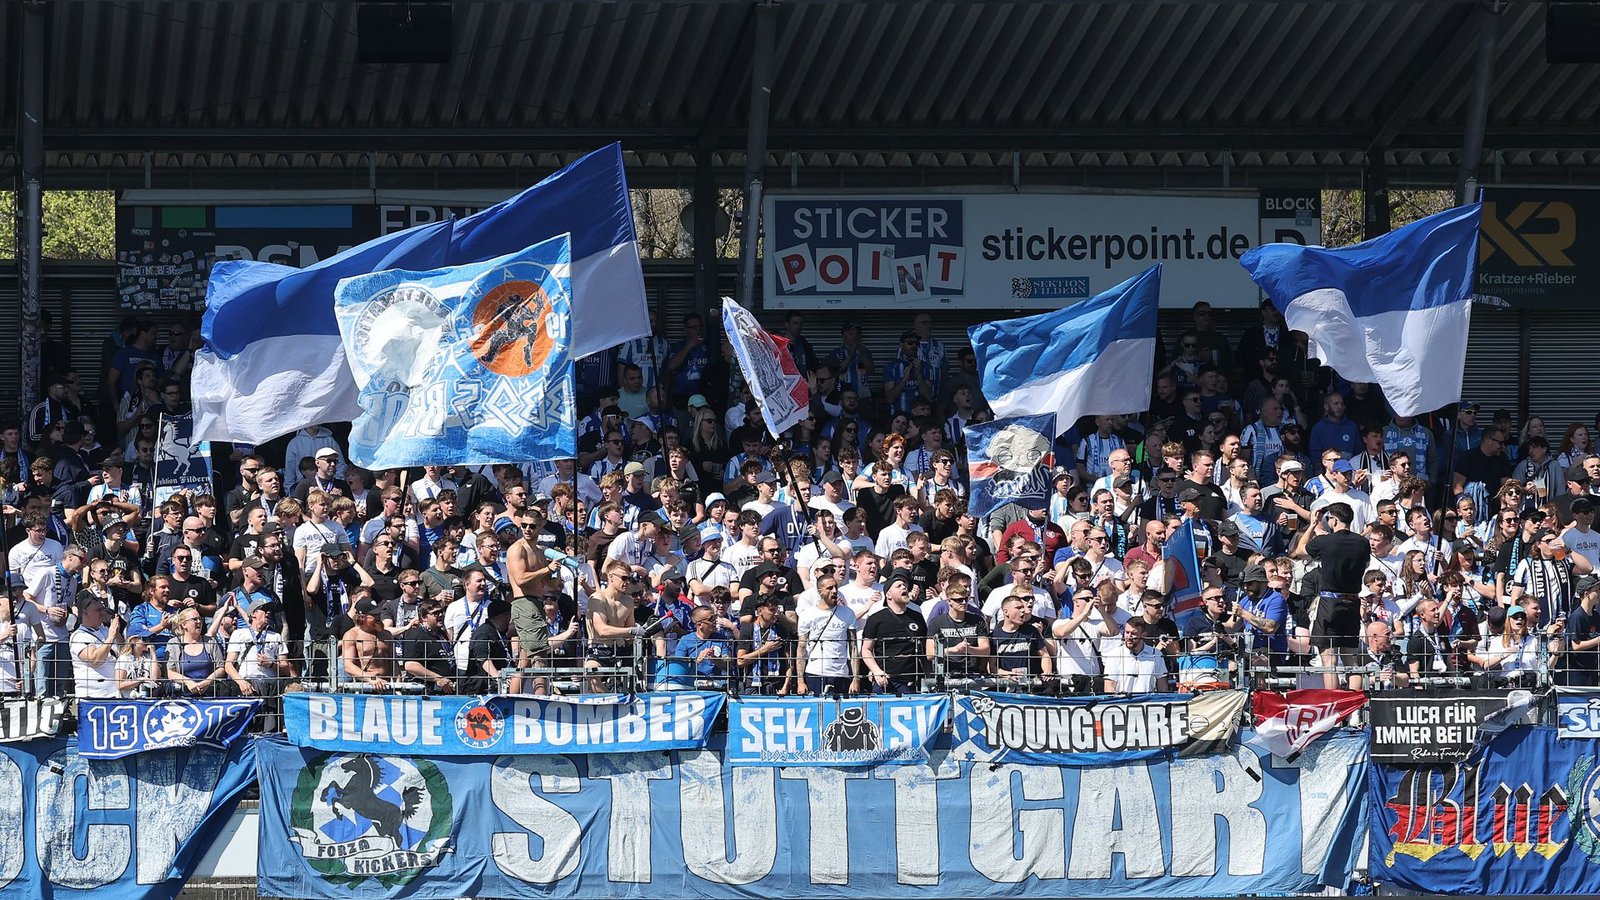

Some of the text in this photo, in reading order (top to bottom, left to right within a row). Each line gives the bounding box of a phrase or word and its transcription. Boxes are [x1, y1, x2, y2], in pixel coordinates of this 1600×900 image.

[1265, 198, 1316, 211] BLOCK
[793, 207, 949, 239] STICKER
[982, 226, 1249, 269] stickerpoint.de
[782, 250, 958, 295] POINT
[1033, 279, 1086, 287] SEKTION
[1480, 272, 1577, 284] Kratzer+Rieber
[1033, 287, 1086, 295] FILDERN
[0, 699, 67, 739] TIC
[87, 705, 138, 750] 13
[309, 695, 706, 745] BLAUE BOMBER
[740, 705, 941, 752] SEK SV
[982, 702, 1190, 751] YOUNG CARE
[1396, 702, 1476, 724] LUCA FÜR
[1375, 726, 1432, 744] IMMER
[1385, 758, 1569, 868] Blue
[317, 839, 371, 857] FORZA
[353, 853, 432, 874] KICKERS
